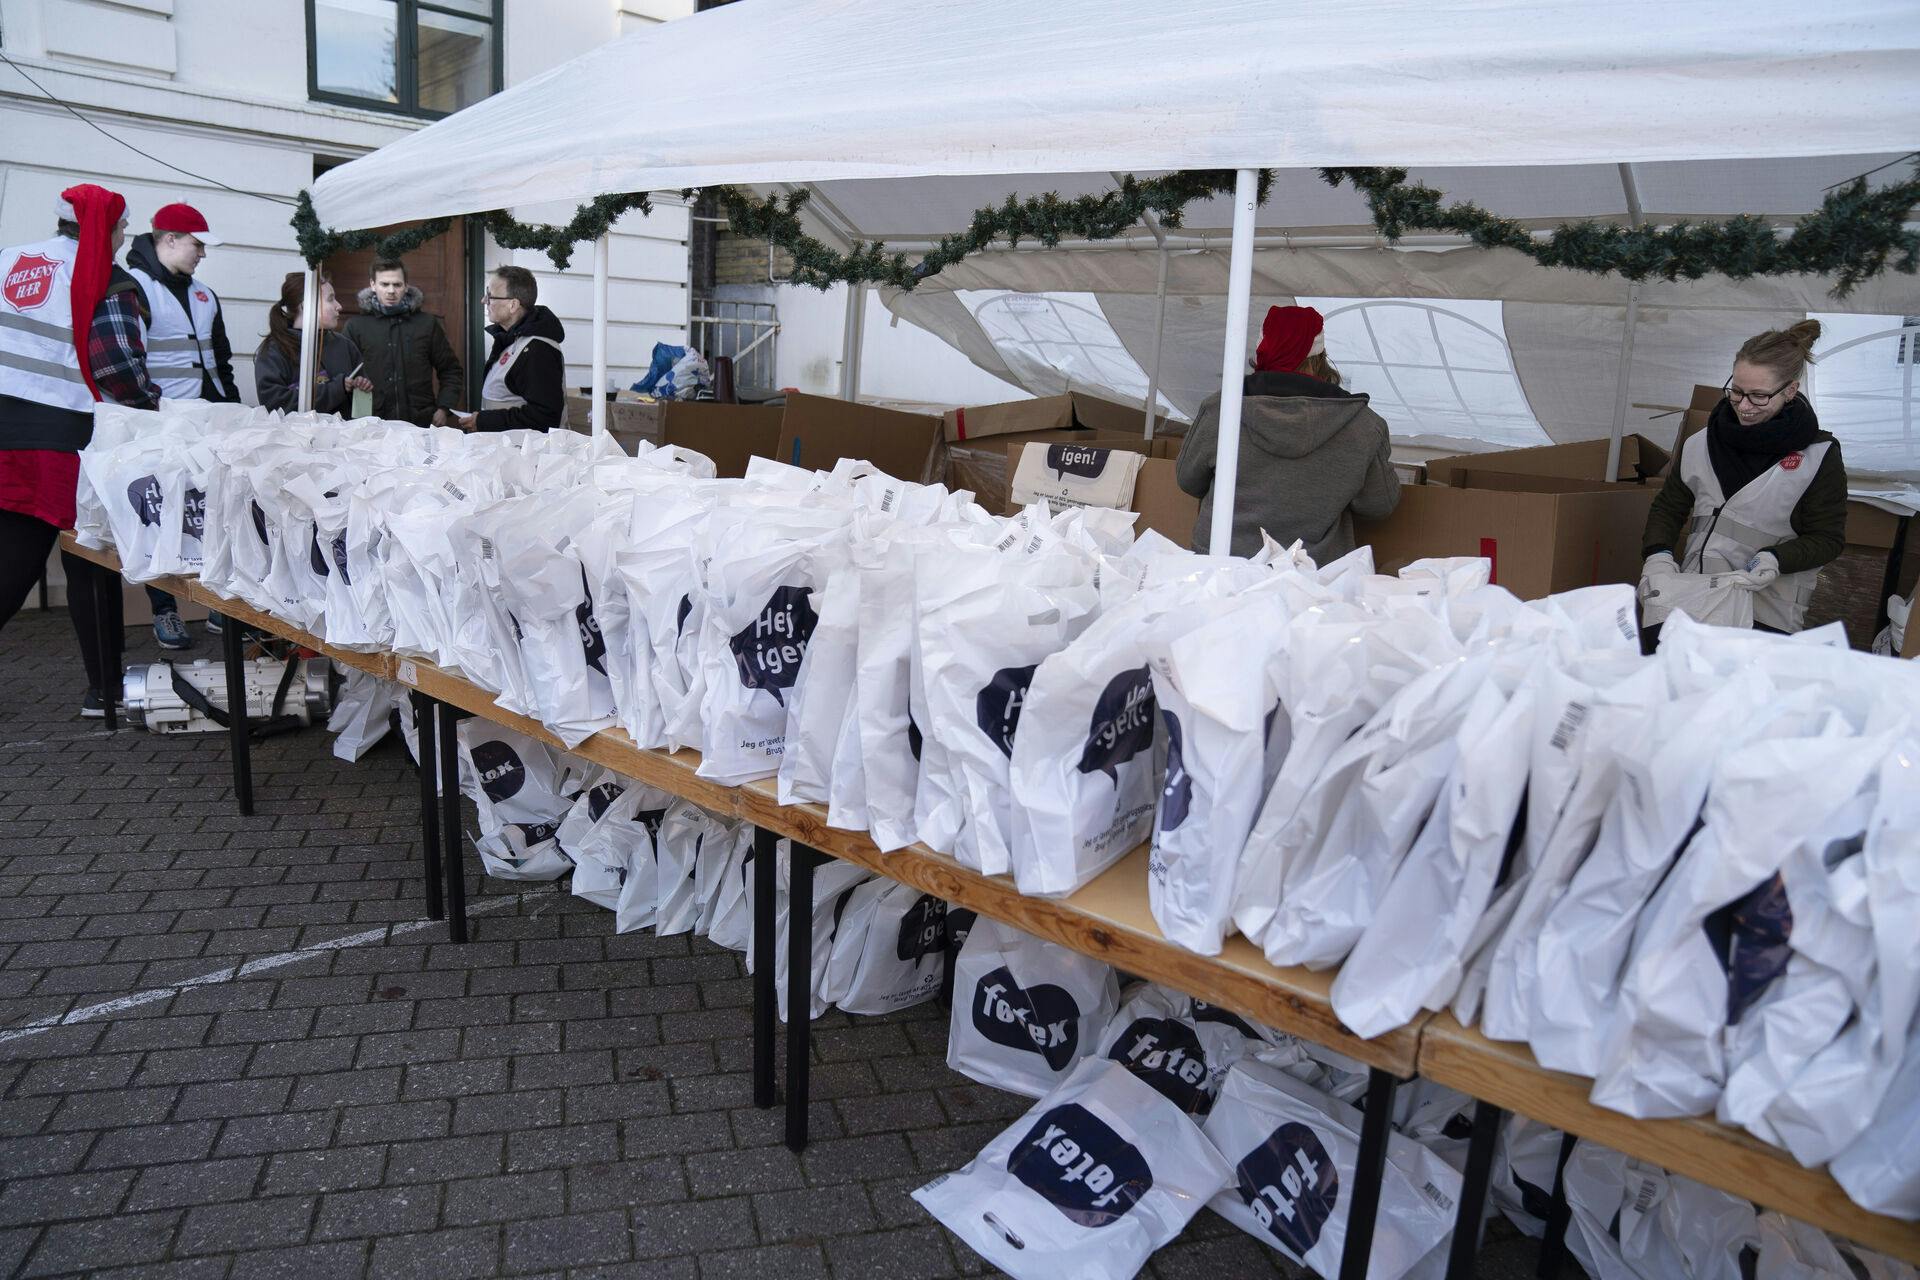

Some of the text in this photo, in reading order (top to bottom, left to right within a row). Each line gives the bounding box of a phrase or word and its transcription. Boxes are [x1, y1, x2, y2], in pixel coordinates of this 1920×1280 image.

[1061, 447, 1097, 465] igen!
[756, 603, 794, 639] Hej
[740, 740, 756, 749] Jeg
[759, 740, 766, 748] er
[1031, 1124, 1126, 1207] føtex
